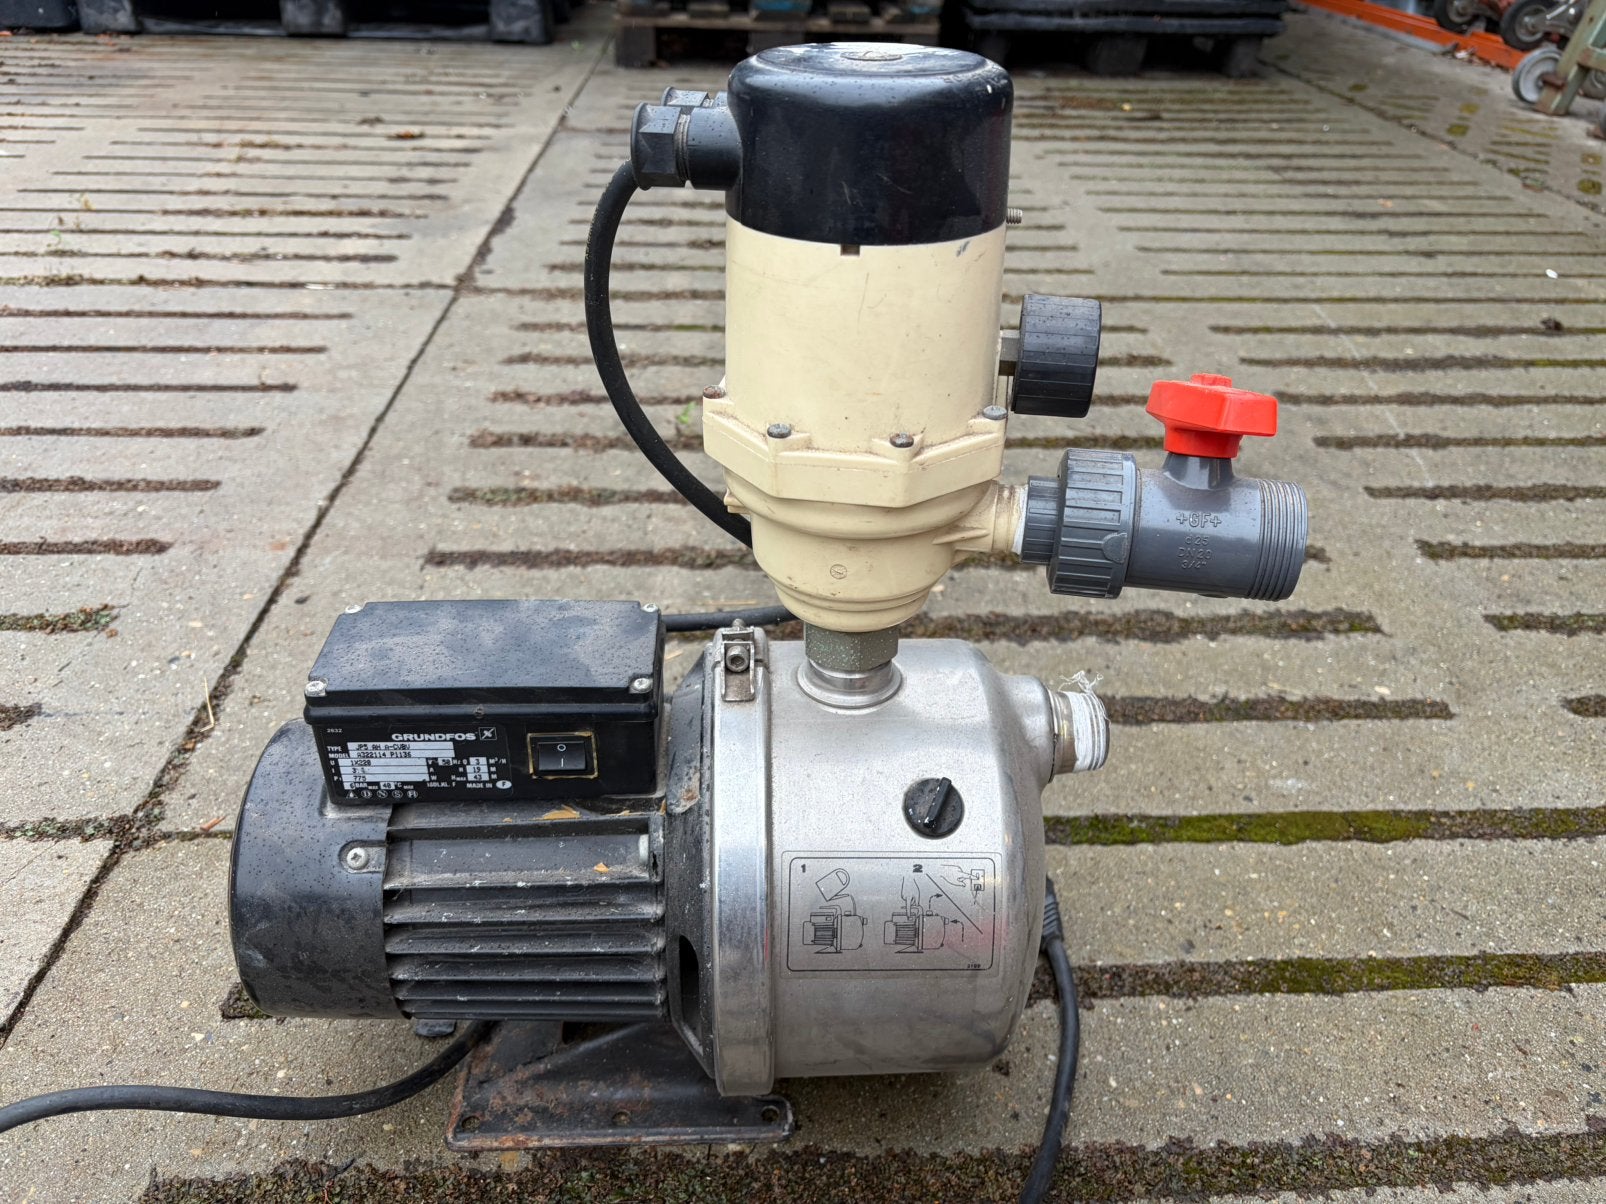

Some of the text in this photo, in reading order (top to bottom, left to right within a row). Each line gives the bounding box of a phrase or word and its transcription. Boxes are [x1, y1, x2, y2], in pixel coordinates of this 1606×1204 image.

[391, 733, 477, 741] GRUNDFOS
[801, 863, 806, 873] 1
[912, 864, 924, 873] 2
